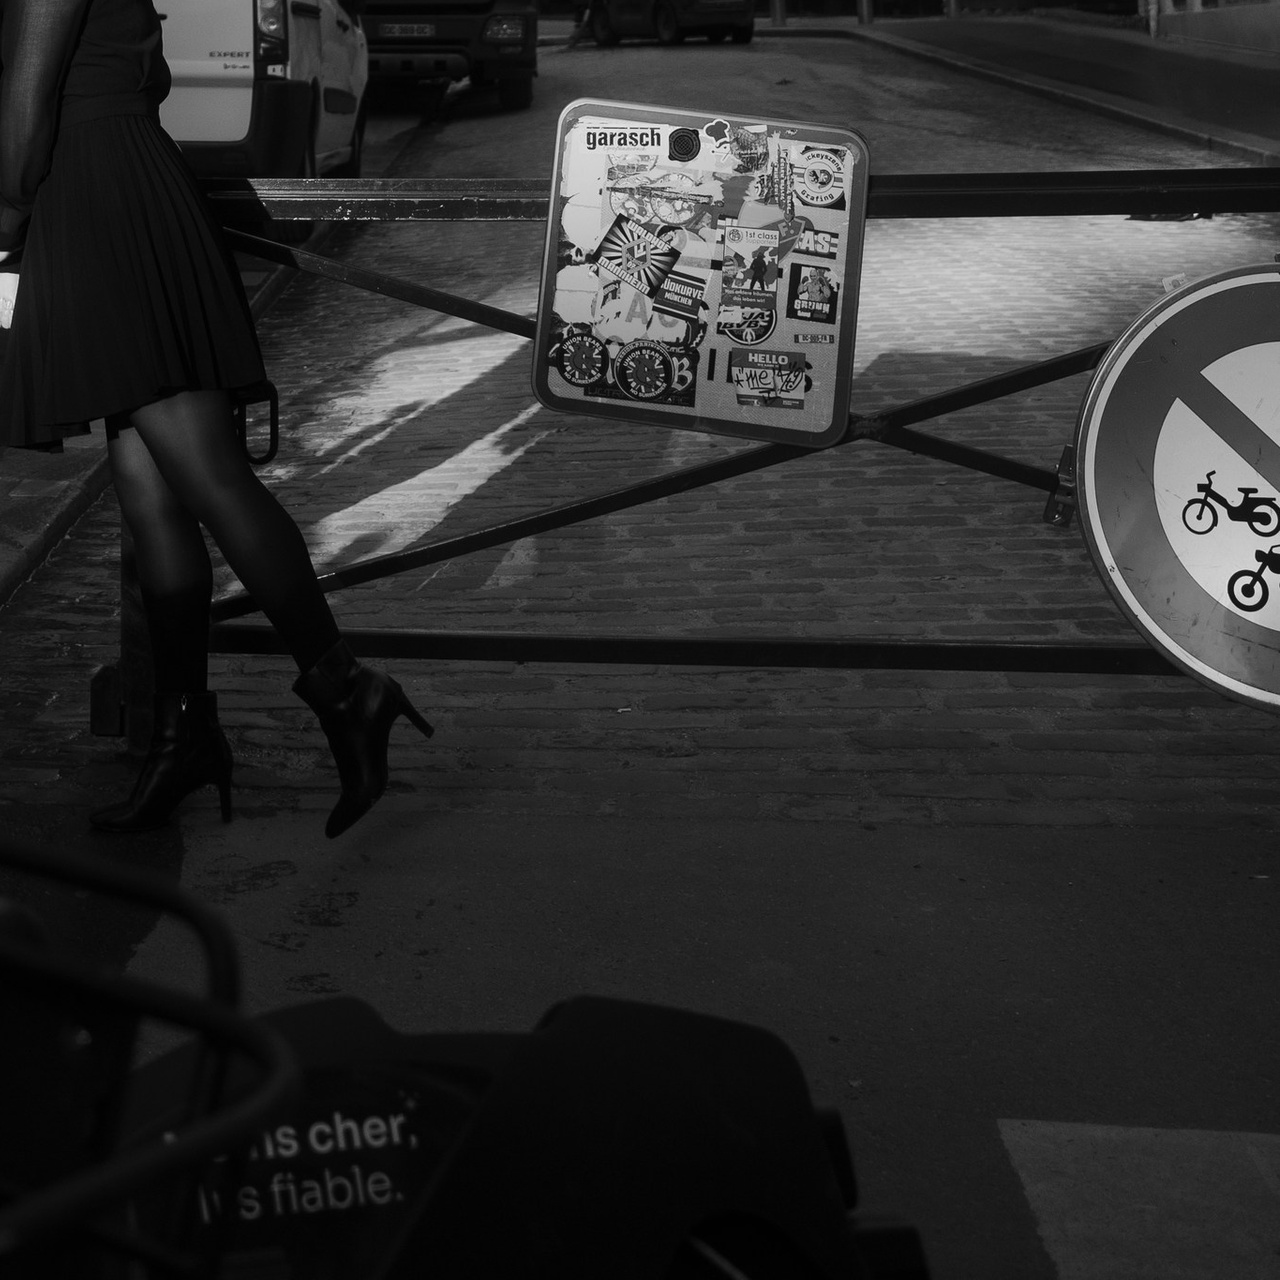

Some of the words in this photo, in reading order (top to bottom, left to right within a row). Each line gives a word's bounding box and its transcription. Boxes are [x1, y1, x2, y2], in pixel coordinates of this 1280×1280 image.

[586, 127, 661, 150] garasch
[805, 153, 842, 171] ckeyszene
[757, 231, 778, 240] class
[661, 278, 703, 300] ÜDKURVE
[562, 336, 582, 351] UNION
[583, 336, 603, 352] BEARS
[748, 352, 789, 365] HELLO
[307, 1110, 419, 1154] cher,
[270, 1164, 405, 1216] fiable.
